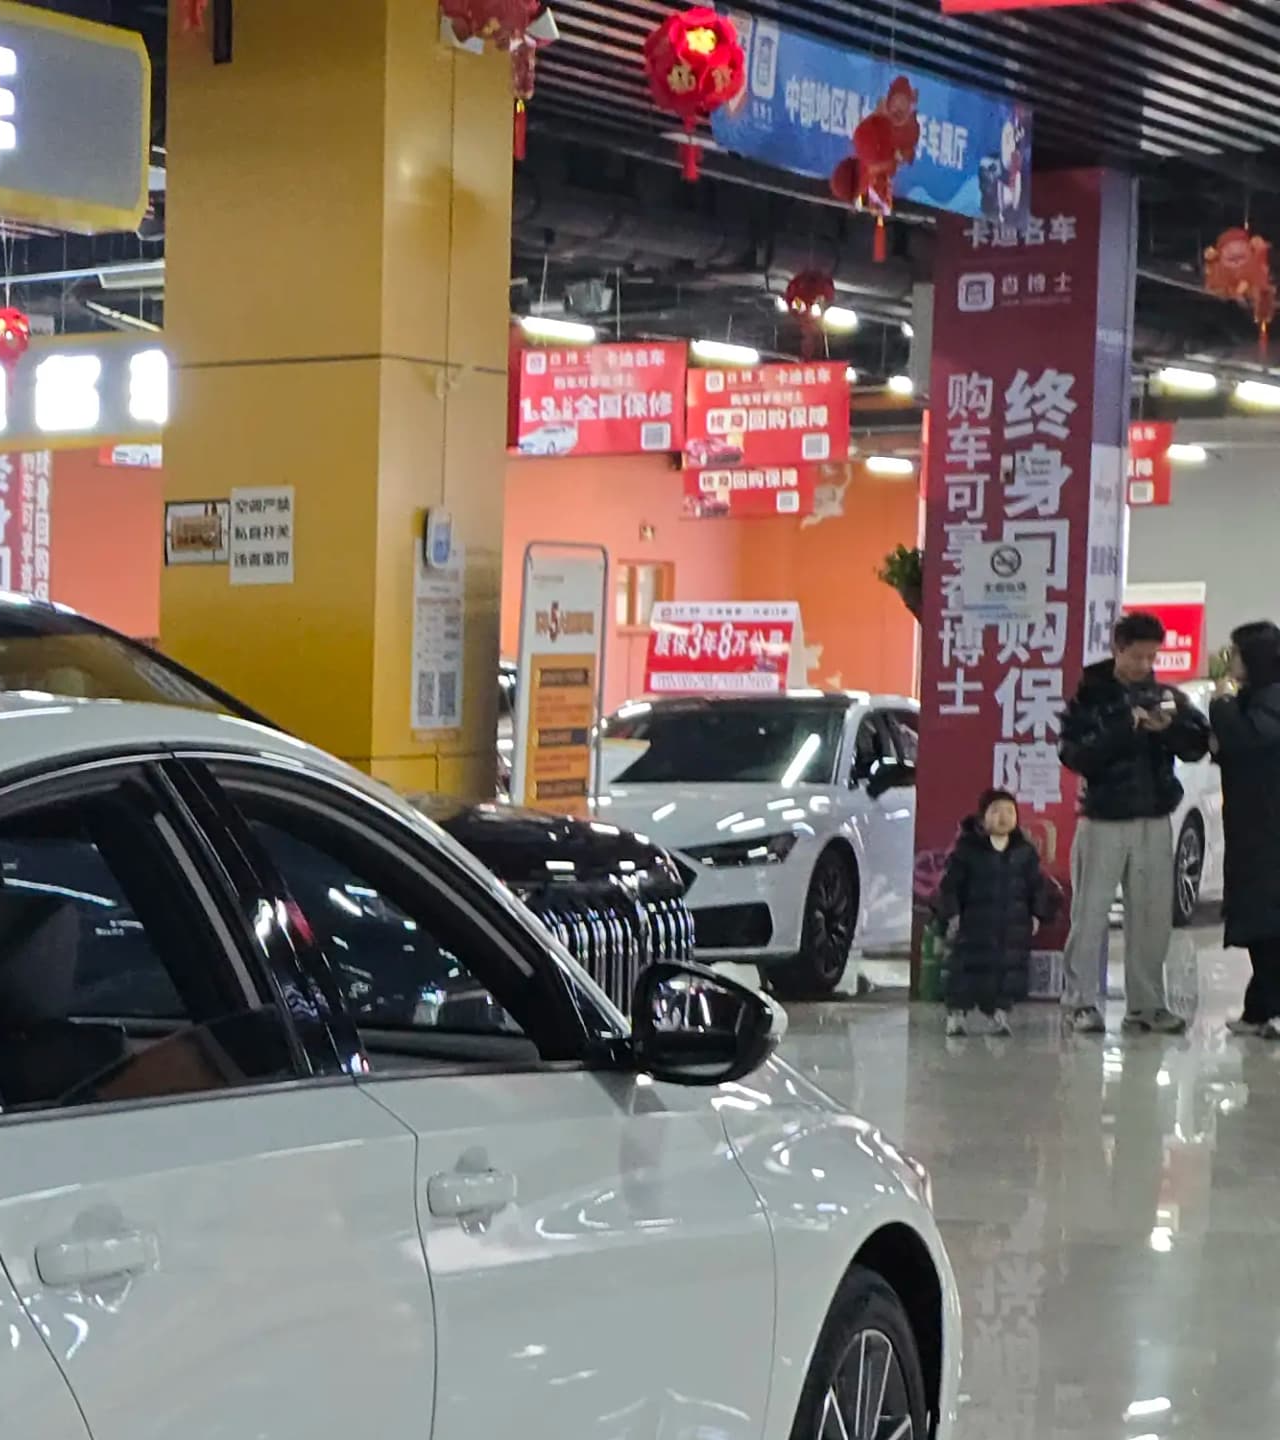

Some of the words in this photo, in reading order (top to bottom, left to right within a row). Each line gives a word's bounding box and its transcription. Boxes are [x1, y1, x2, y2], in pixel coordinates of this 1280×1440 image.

[784, 74, 969, 171] 中部地区最手车展厅
